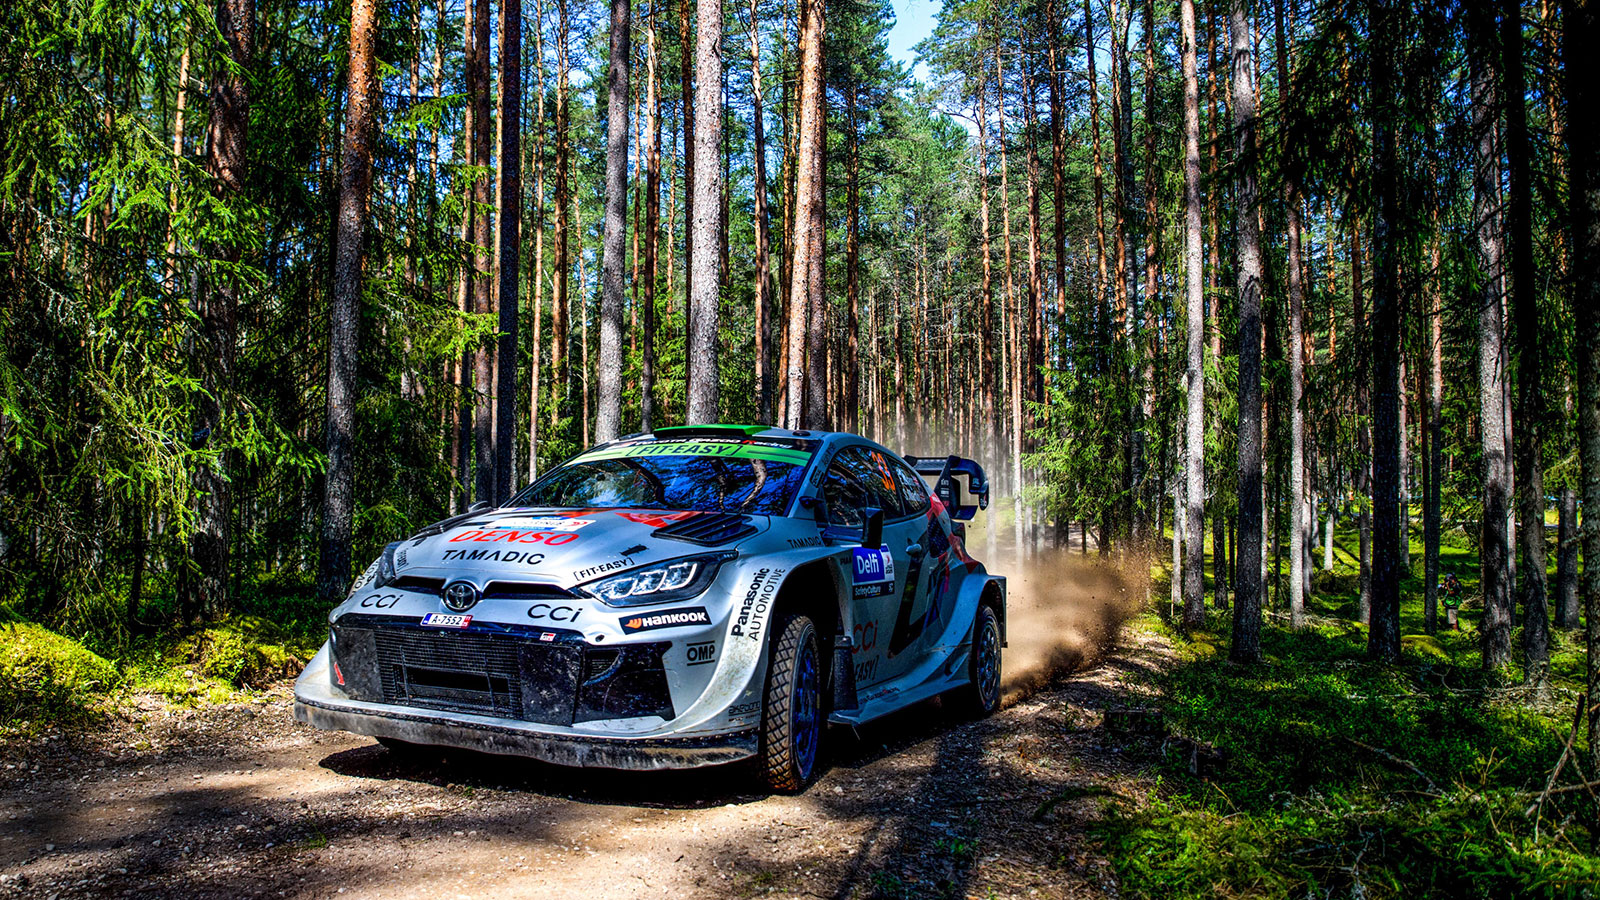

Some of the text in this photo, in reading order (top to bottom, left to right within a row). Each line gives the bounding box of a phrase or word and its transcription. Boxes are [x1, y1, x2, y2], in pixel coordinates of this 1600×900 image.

[449, 530, 580, 546] DENSO
[787, 536, 822, 549] TAMADIC
[441, 549, 546, 565] TAMADIC
[856, 553, 880, 575] Delfi
[731, 567, 771, 637] Panasonic
[749, 567, 786, 642] AUTOMOTIVE
[686, 644, 716, 661] OMP
